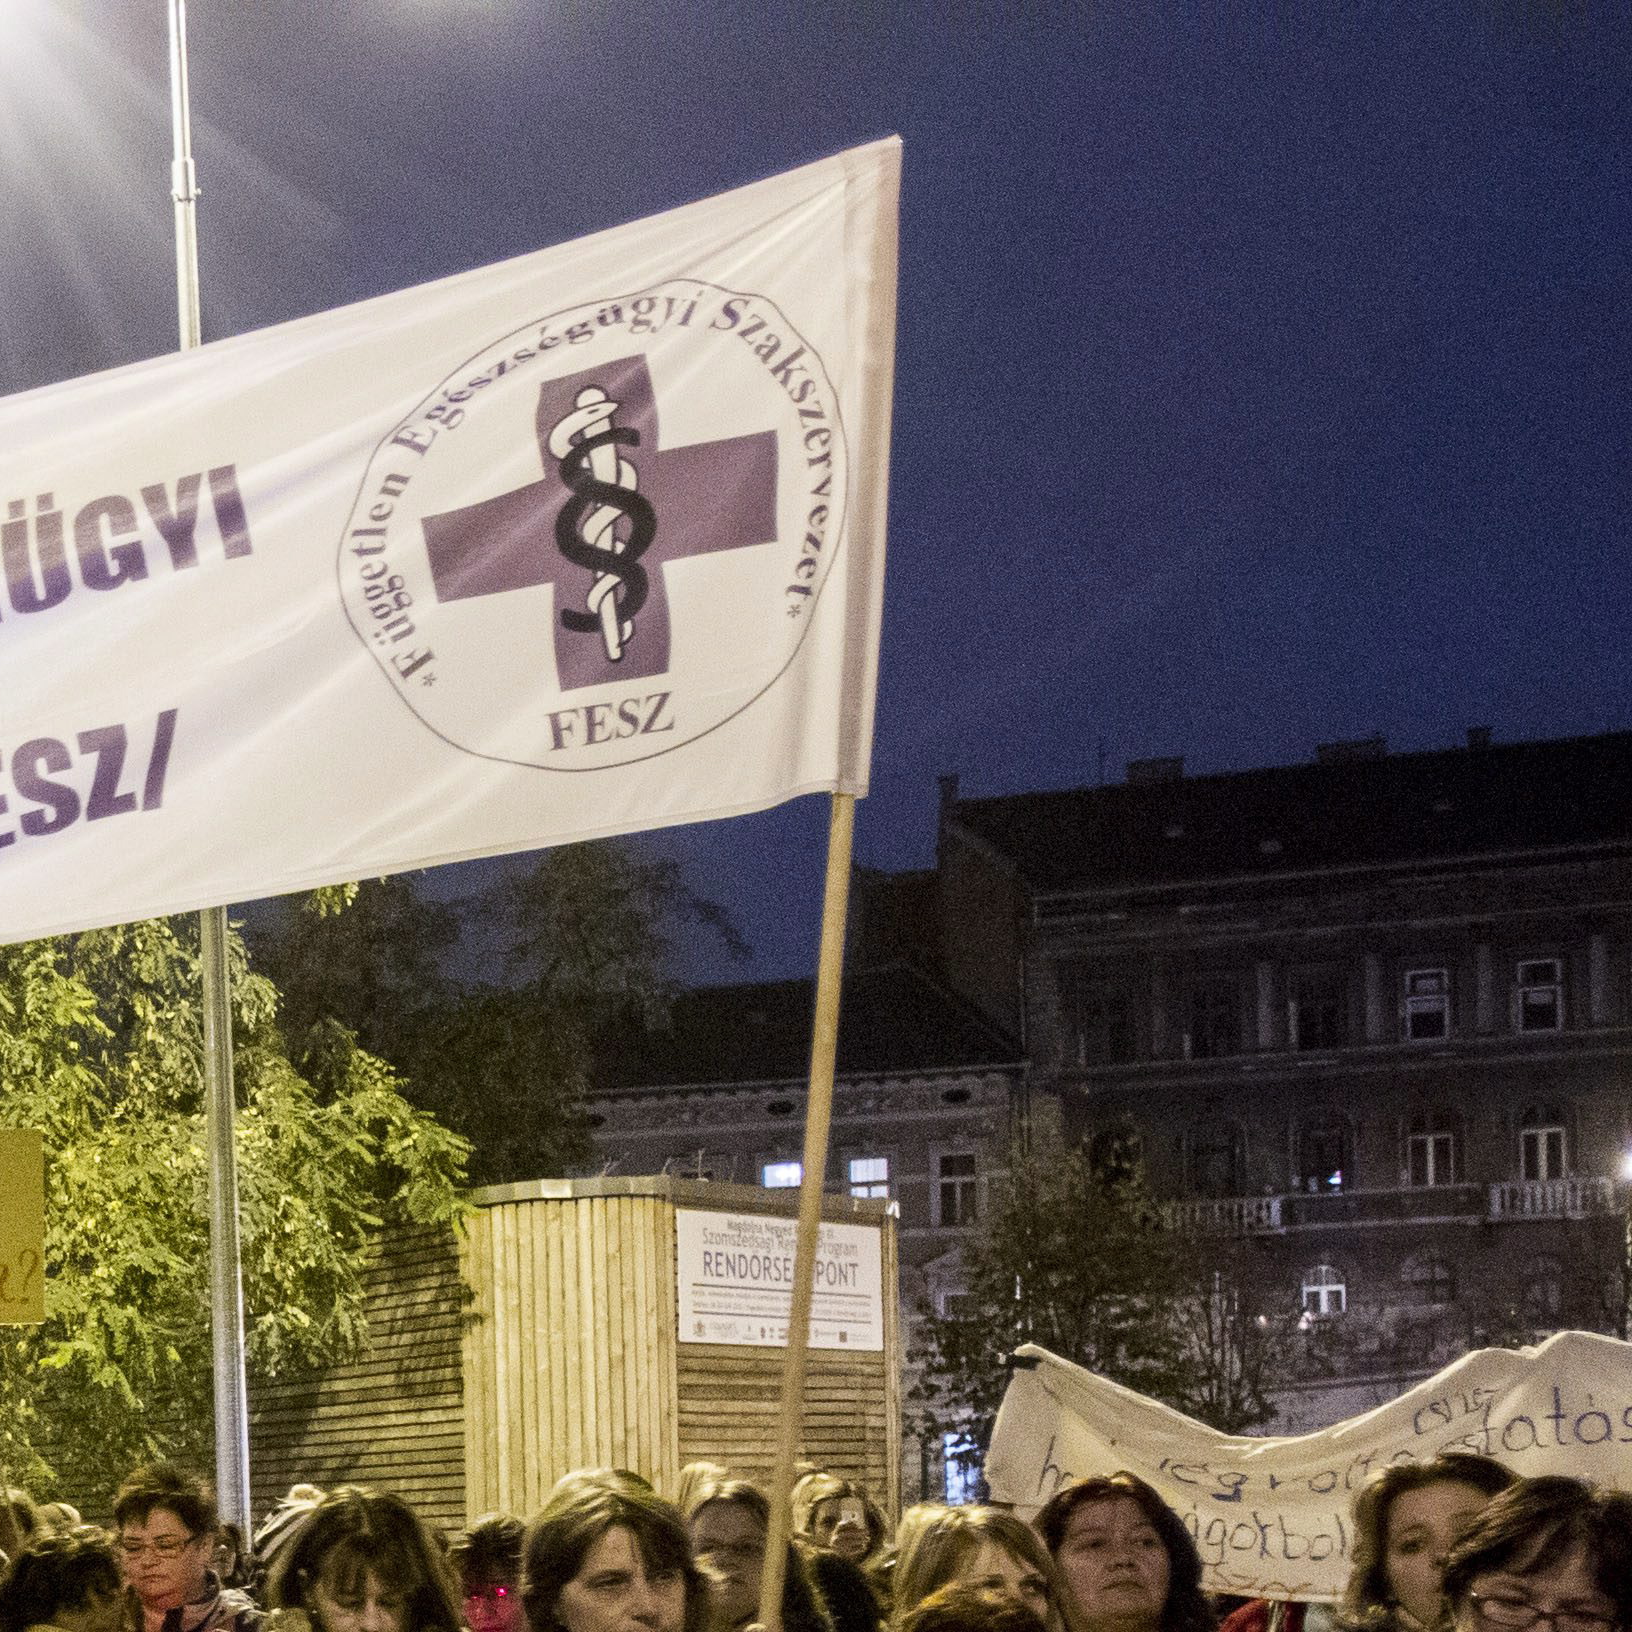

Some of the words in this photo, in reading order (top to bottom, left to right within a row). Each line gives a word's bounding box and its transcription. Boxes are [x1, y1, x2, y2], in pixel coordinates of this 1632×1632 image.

[391, 290, 704, 457] Egészségügyi
[709, 297, 833, 601] Szakszervezet
[350, 471, 435, 680] Független
[544, 691, 676, 751] FESZ
